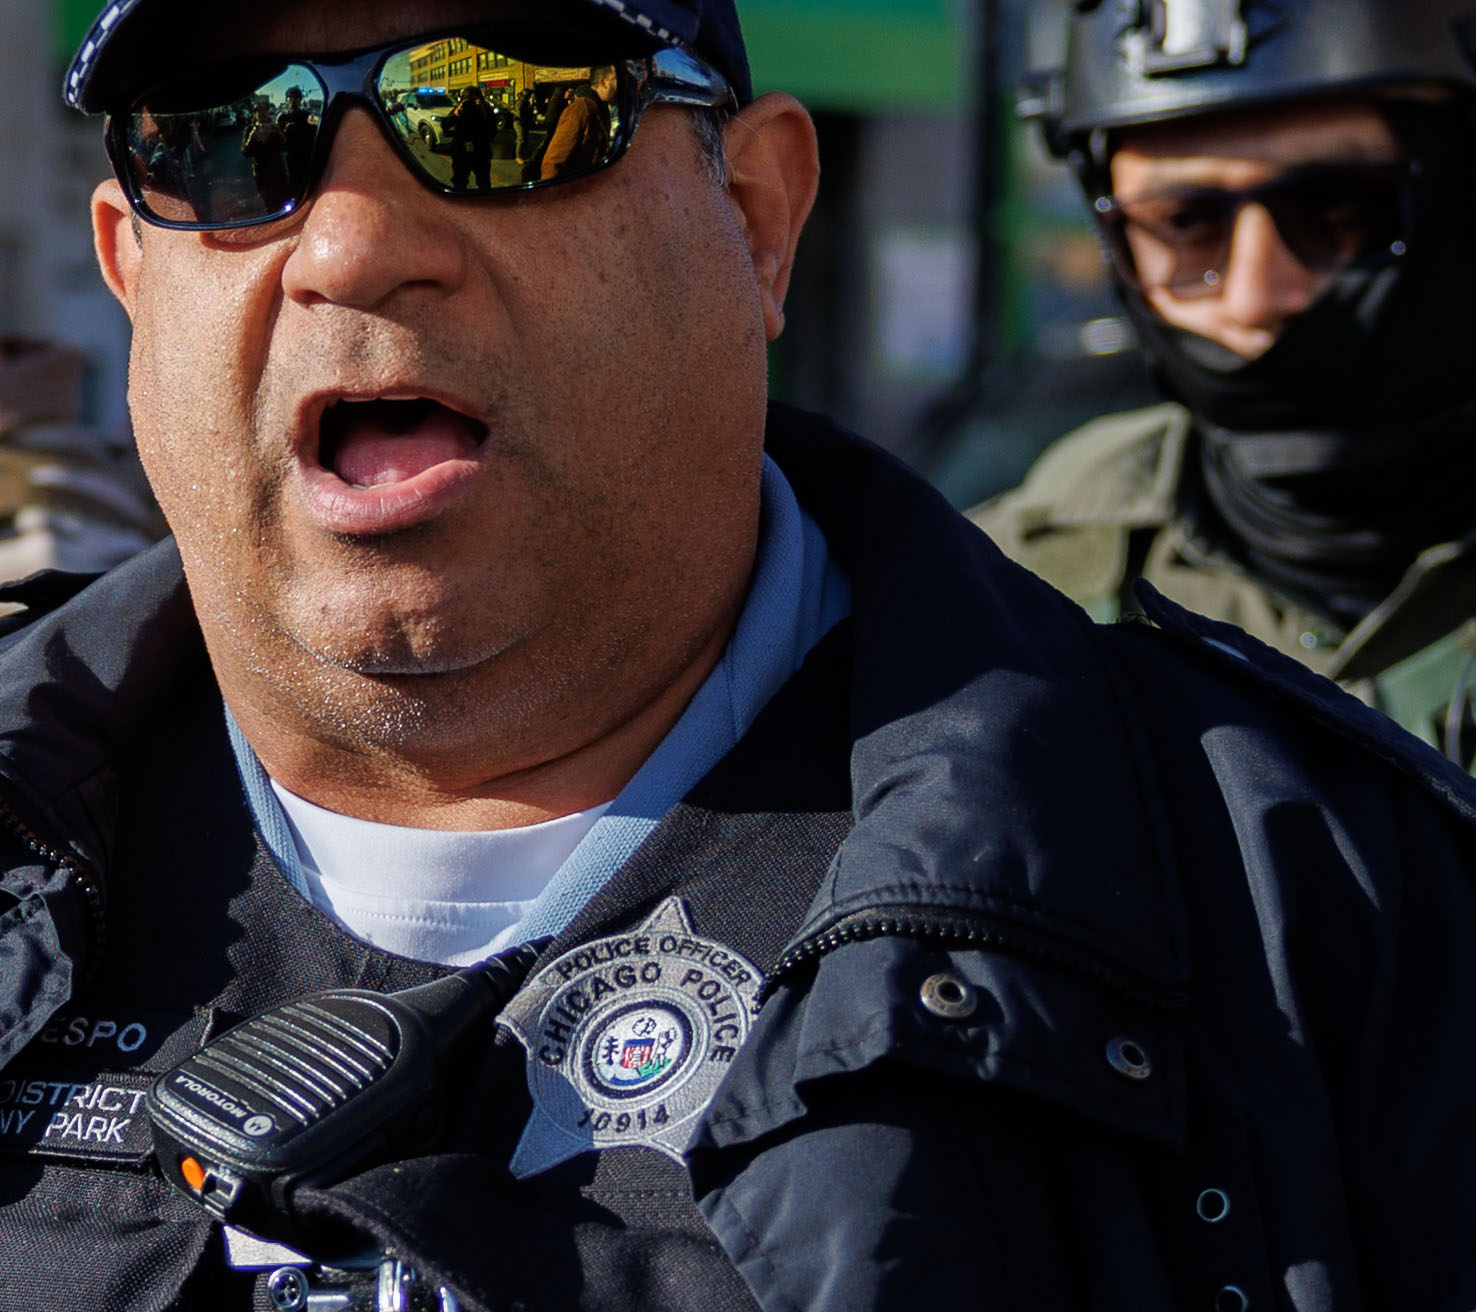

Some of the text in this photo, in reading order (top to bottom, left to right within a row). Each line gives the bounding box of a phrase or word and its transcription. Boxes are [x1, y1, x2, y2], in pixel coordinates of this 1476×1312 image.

[555, 935, 752, 986] POLICE OFFICER
[538, 961, 739, 1066] CHICAGO POLICE
[175, 1075, 248, 1119] MOTOROLA
[577, 1104, 670, 1133] 10914
[45, 1111, 132, 1143] PARK
